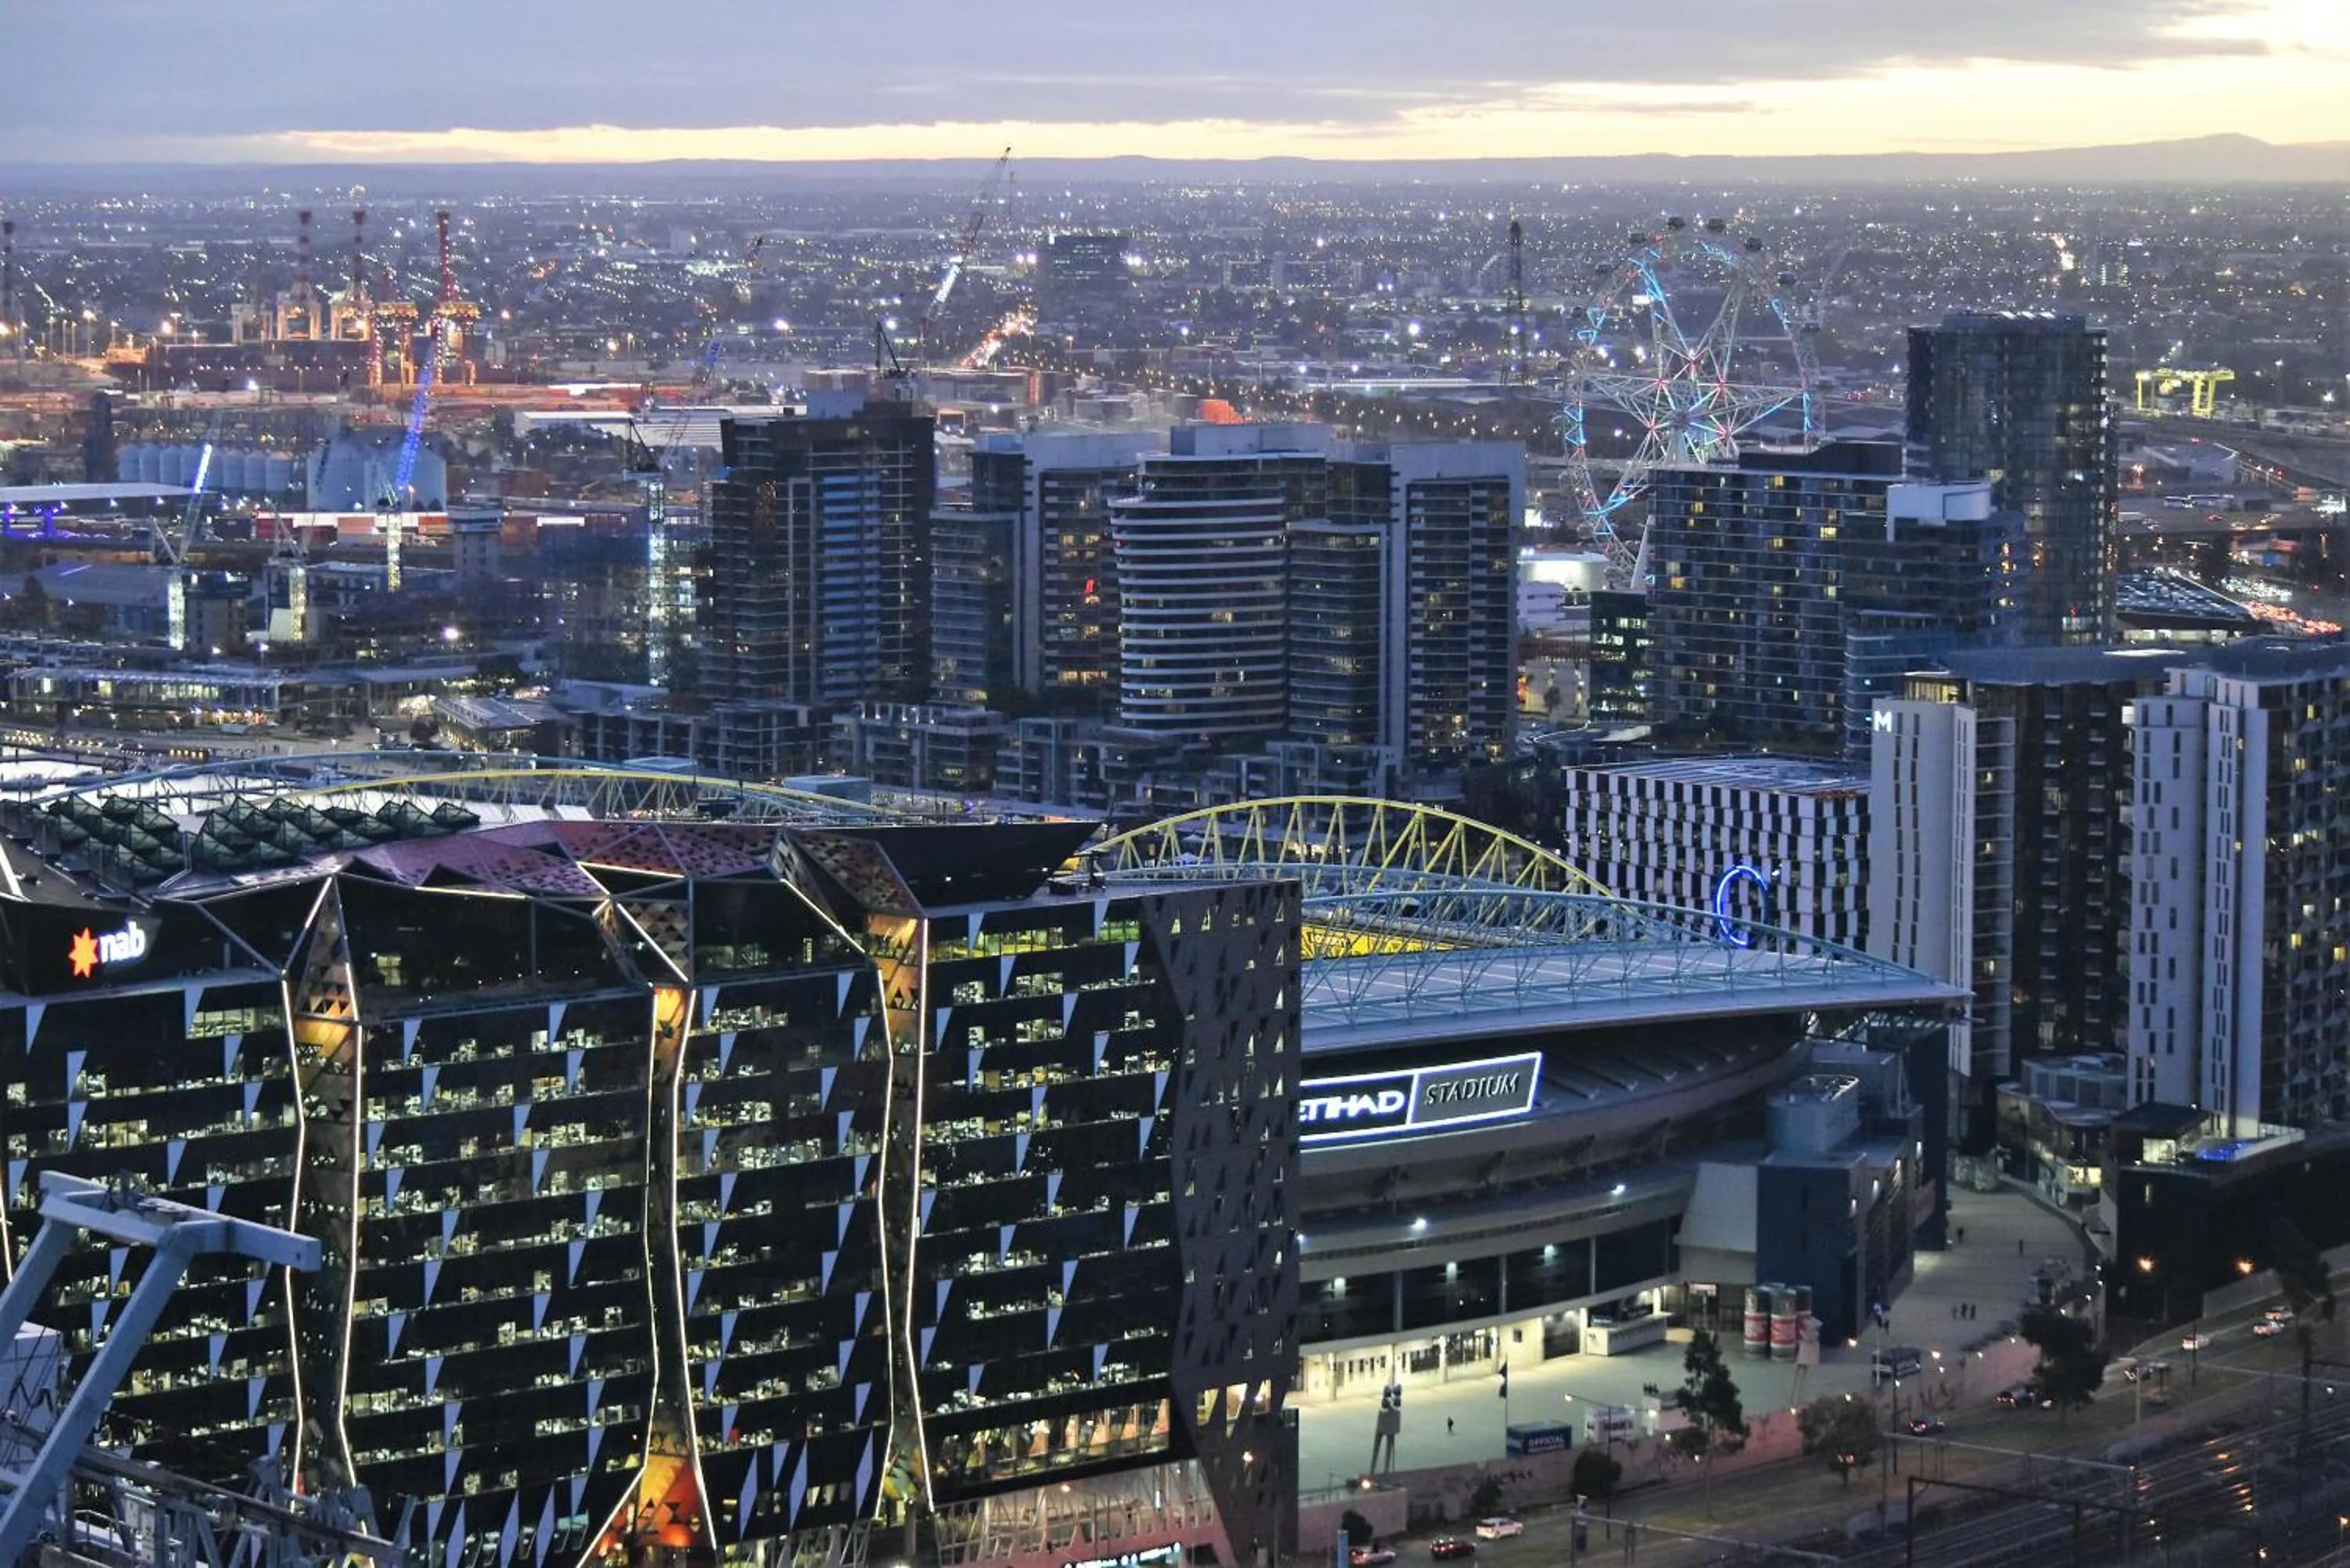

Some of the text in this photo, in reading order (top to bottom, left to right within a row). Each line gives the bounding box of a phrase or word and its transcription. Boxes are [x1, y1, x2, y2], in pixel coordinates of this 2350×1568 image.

[1874, 710, 1892, 732] M
[99, 920, 146, 963] nab
[1424, 1072, 1518, 1105] STADIUM
